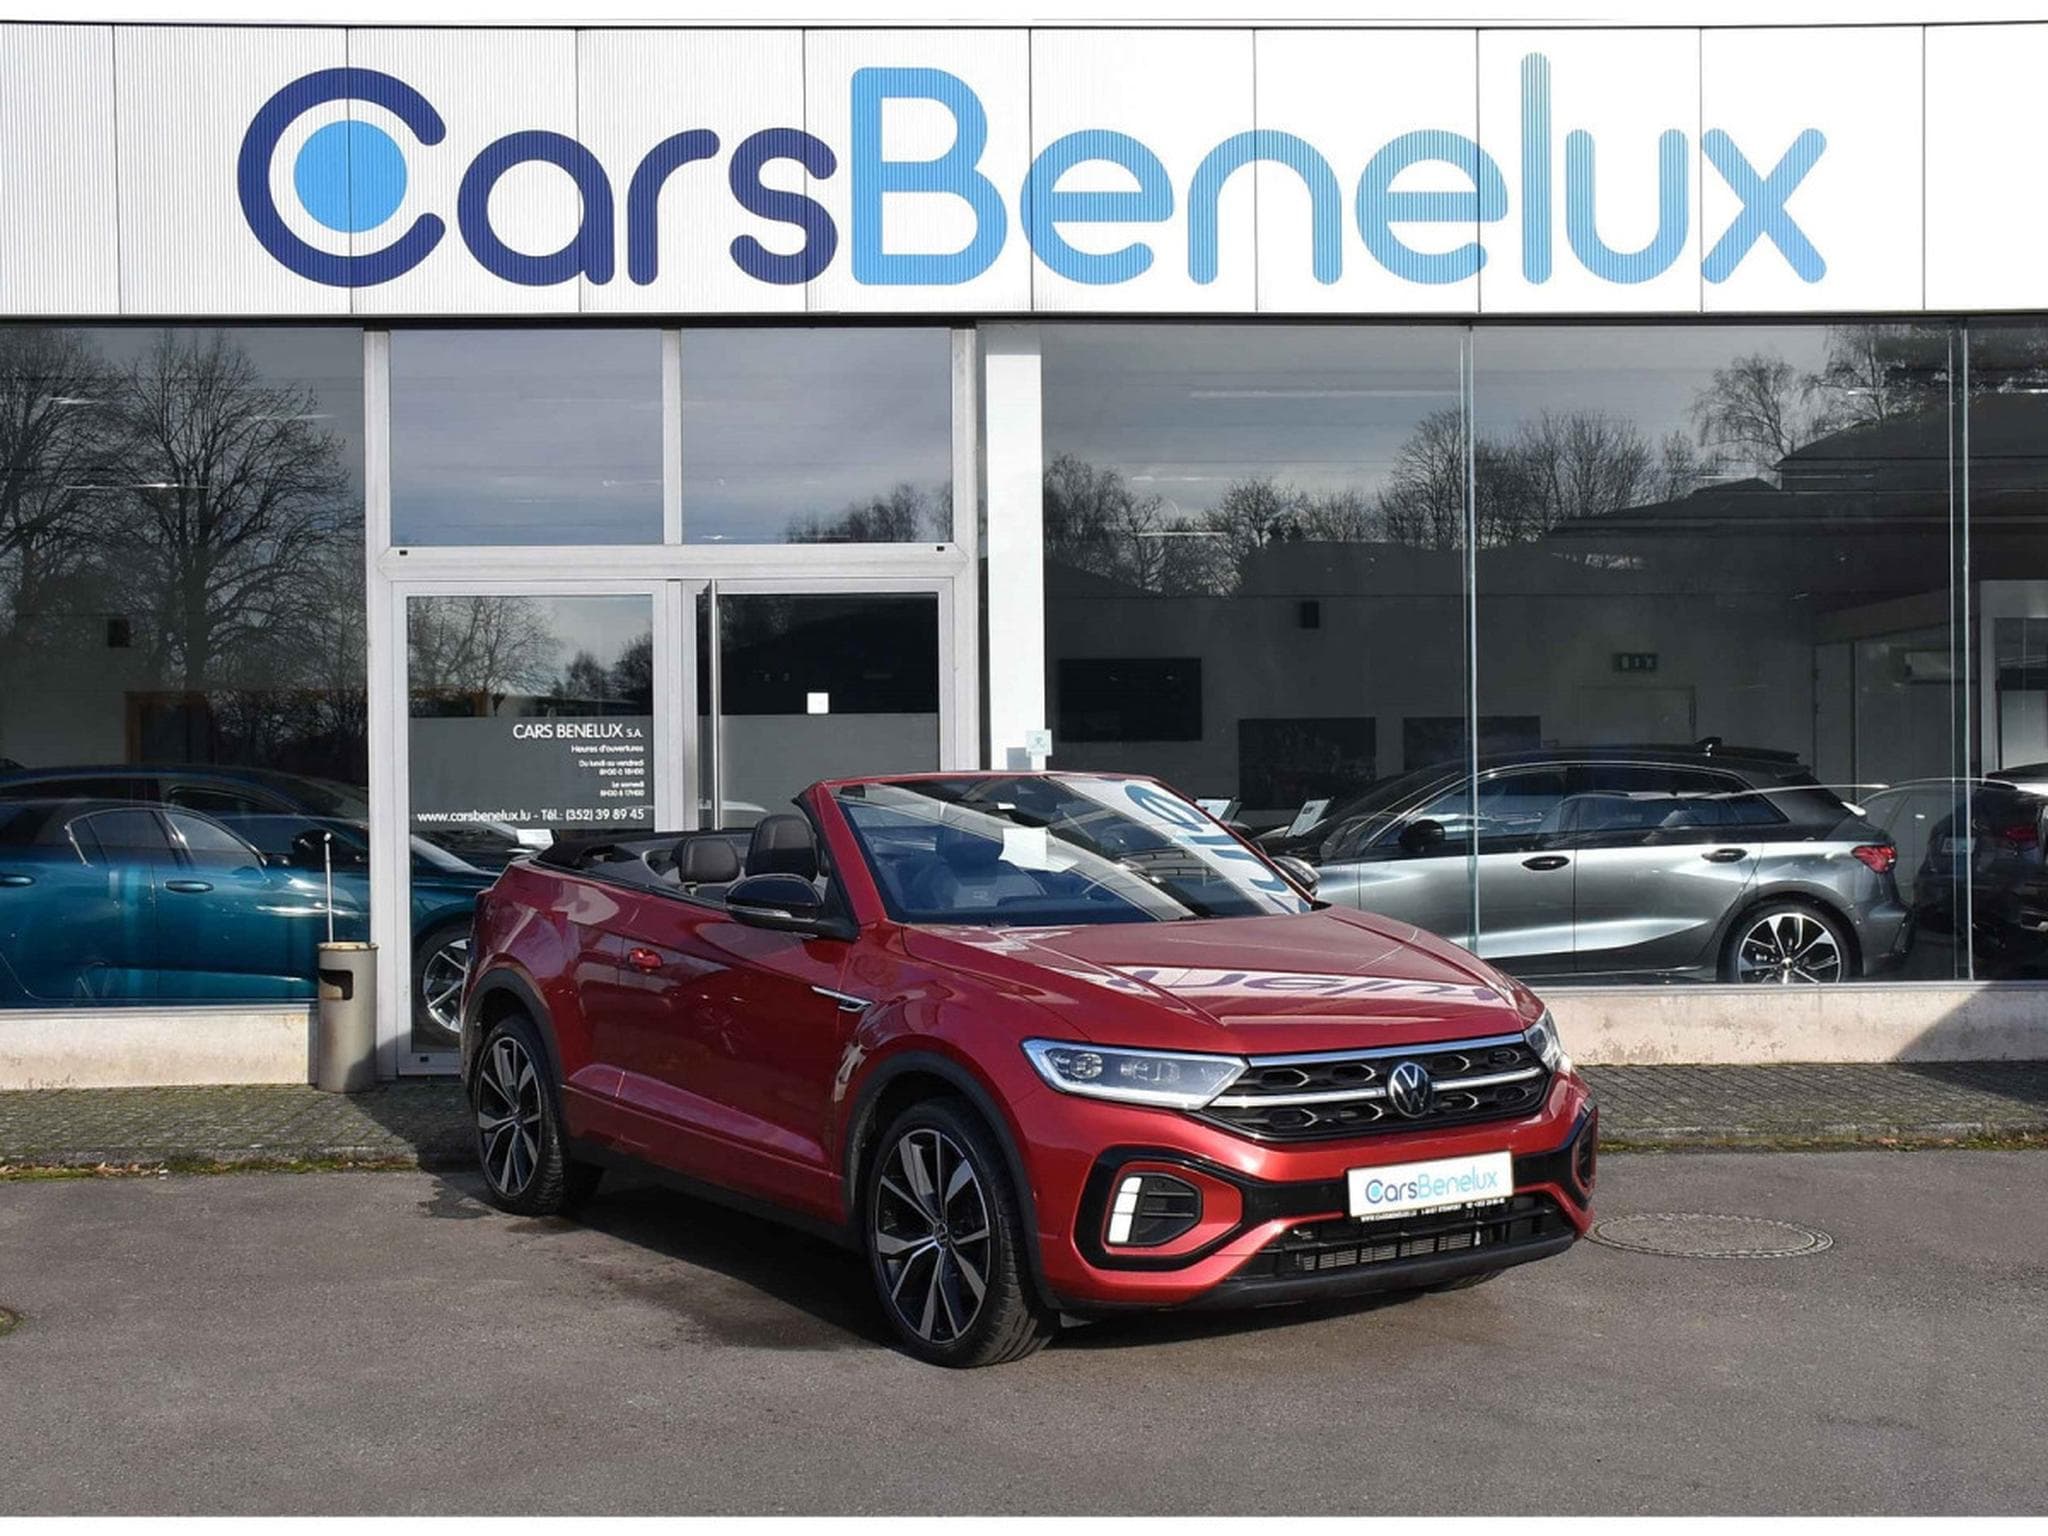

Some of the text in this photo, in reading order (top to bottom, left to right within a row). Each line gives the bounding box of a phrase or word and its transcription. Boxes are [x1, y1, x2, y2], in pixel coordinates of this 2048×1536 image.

[237, 52, 1827, 288] CarsBenelux
[513, 723, 553, 739] CARS
[556, 723, 623, 738] BENELUX
[417, 809, 531, 822] www.carsbenelux.lu
[566, 808, 593, 821] (352)
[595, 808, 610, 820] 39
[612, 808, 627, 820] 89
[629, 808, 644, 820] 45
[1366, 1166, 1498, 1204] CarsBenelux
